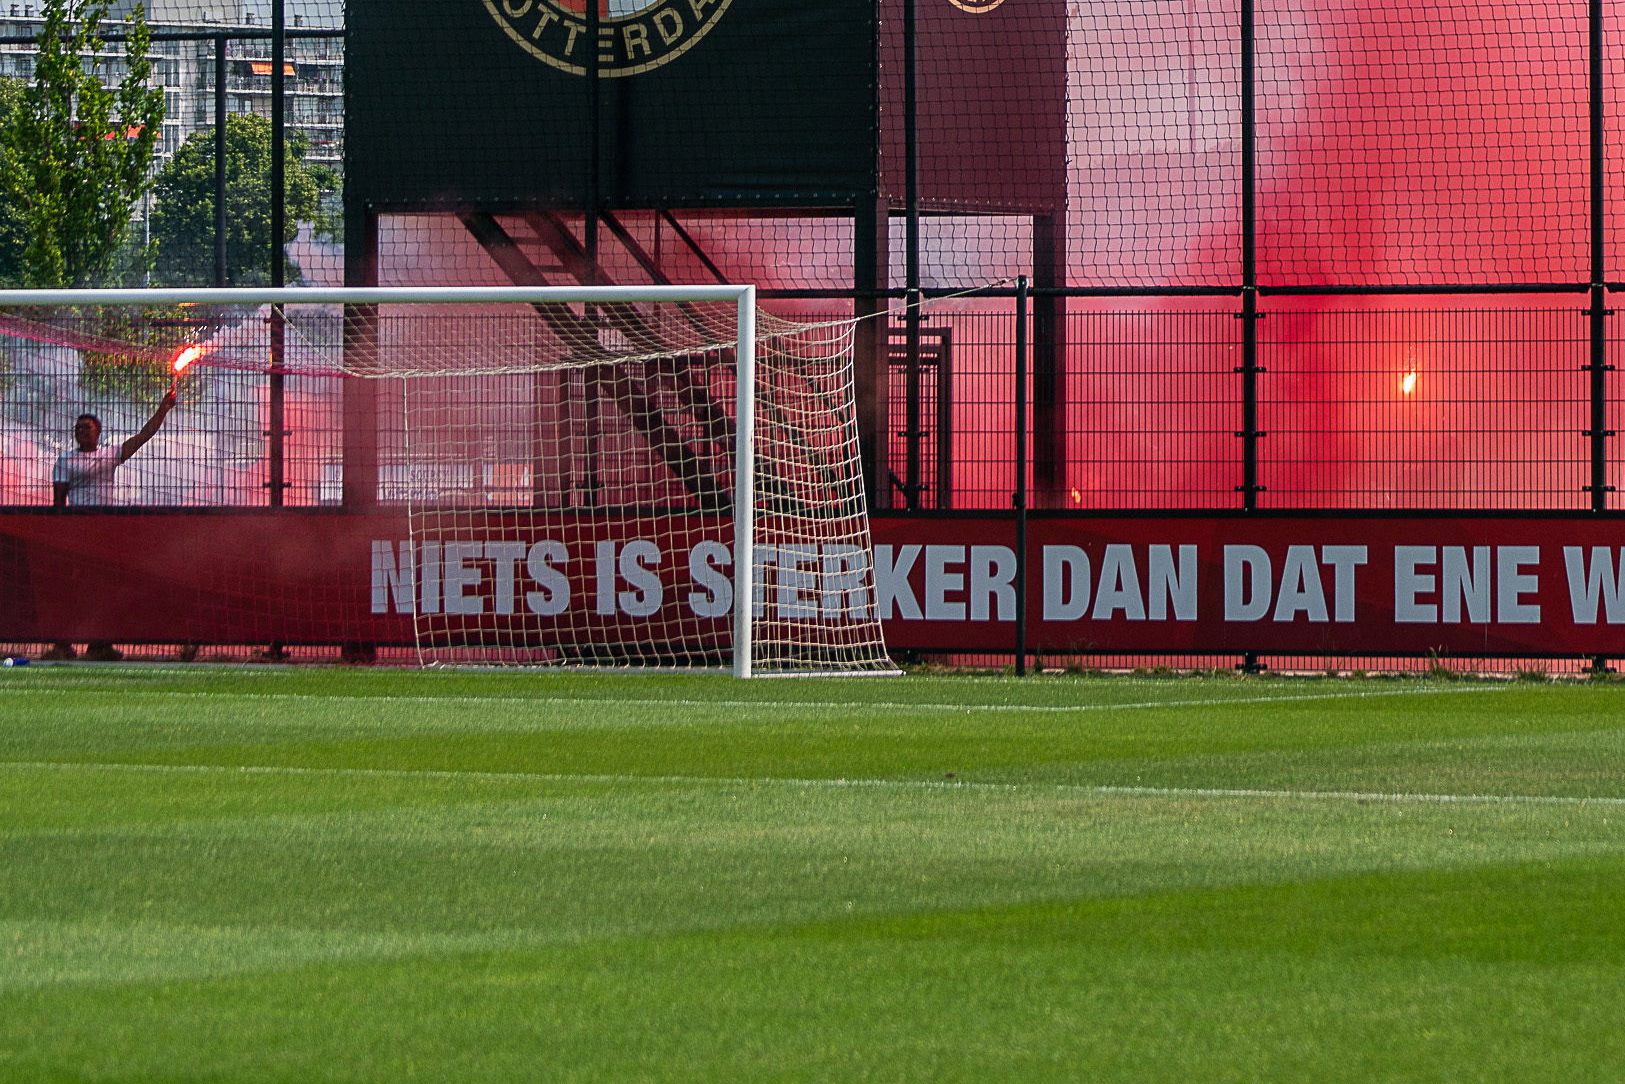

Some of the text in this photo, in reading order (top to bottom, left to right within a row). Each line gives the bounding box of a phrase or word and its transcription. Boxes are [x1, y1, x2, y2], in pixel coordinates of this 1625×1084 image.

[371, 539, 570, 616] NIETS
[596, 540, 664, 617] IS
[1043, 543, 1198, 621] DAN
[1224, 544, 1368, 623] DAT
[1394, 545, 1541, 624] ENE
